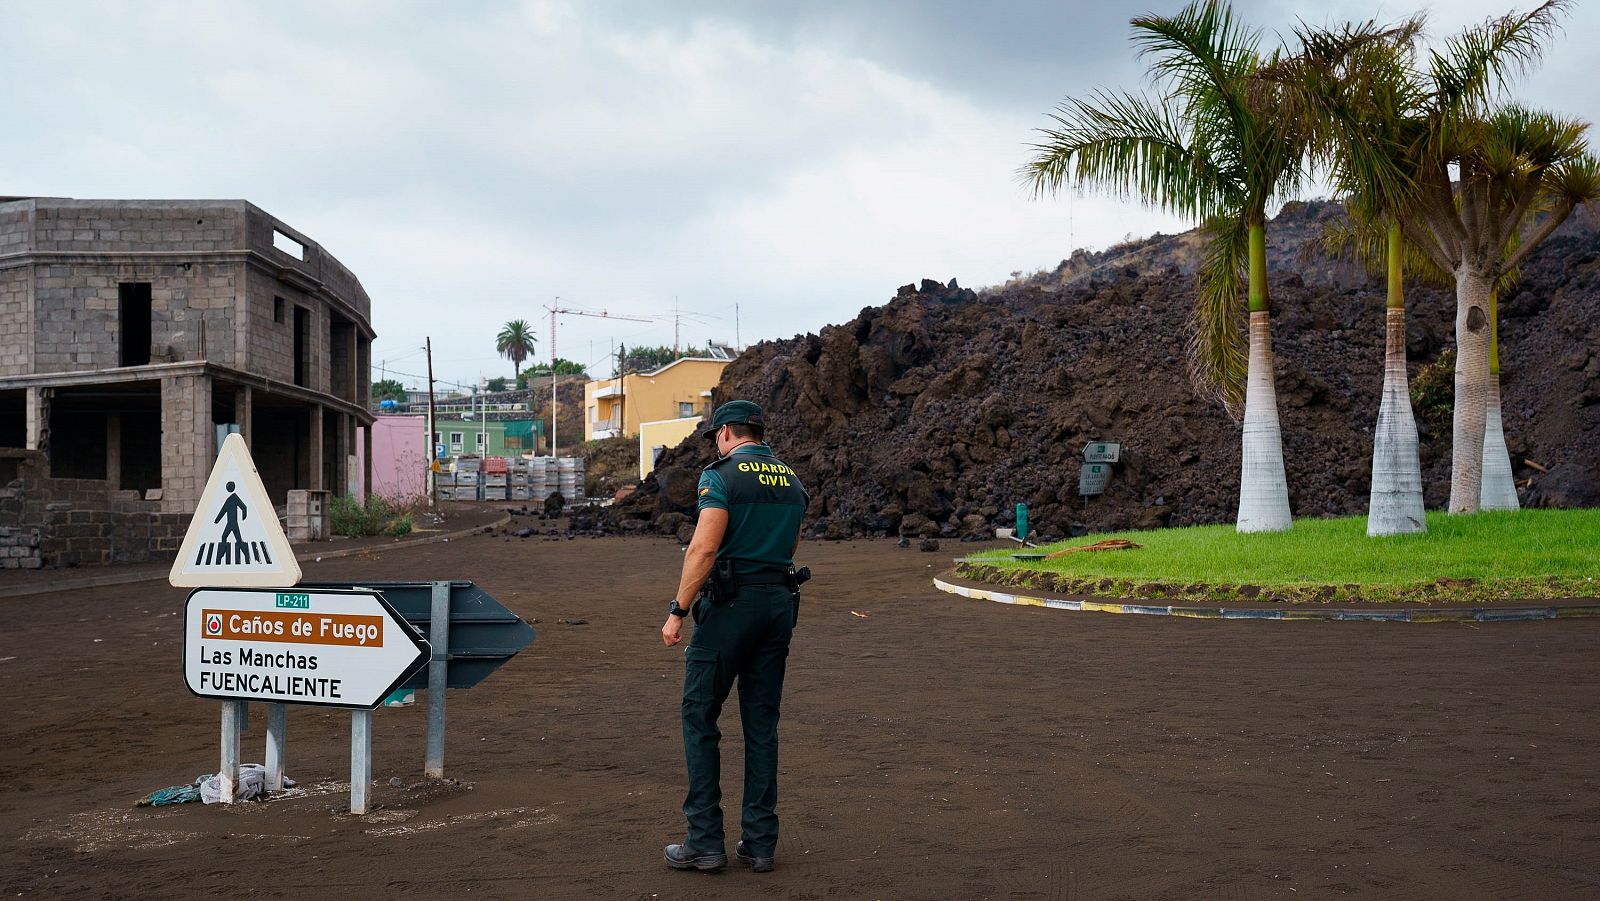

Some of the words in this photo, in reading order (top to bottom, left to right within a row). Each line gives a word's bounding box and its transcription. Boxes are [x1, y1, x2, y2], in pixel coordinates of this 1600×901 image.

[738, 461, 796, 477] GUARDIA
[758, 473, 791, 487] CIVIL
[277, 594, 309, 608] LP-211
[229, 614, 284, 636] Caños
[291, 617, 313, 637] de
[320, 618, 378, 645] Fuego
[200, 645, 232, 665] Las
[239, 647, 318, 670] Manchas
[200, 671, 342, 699] FUENCALIENTE
